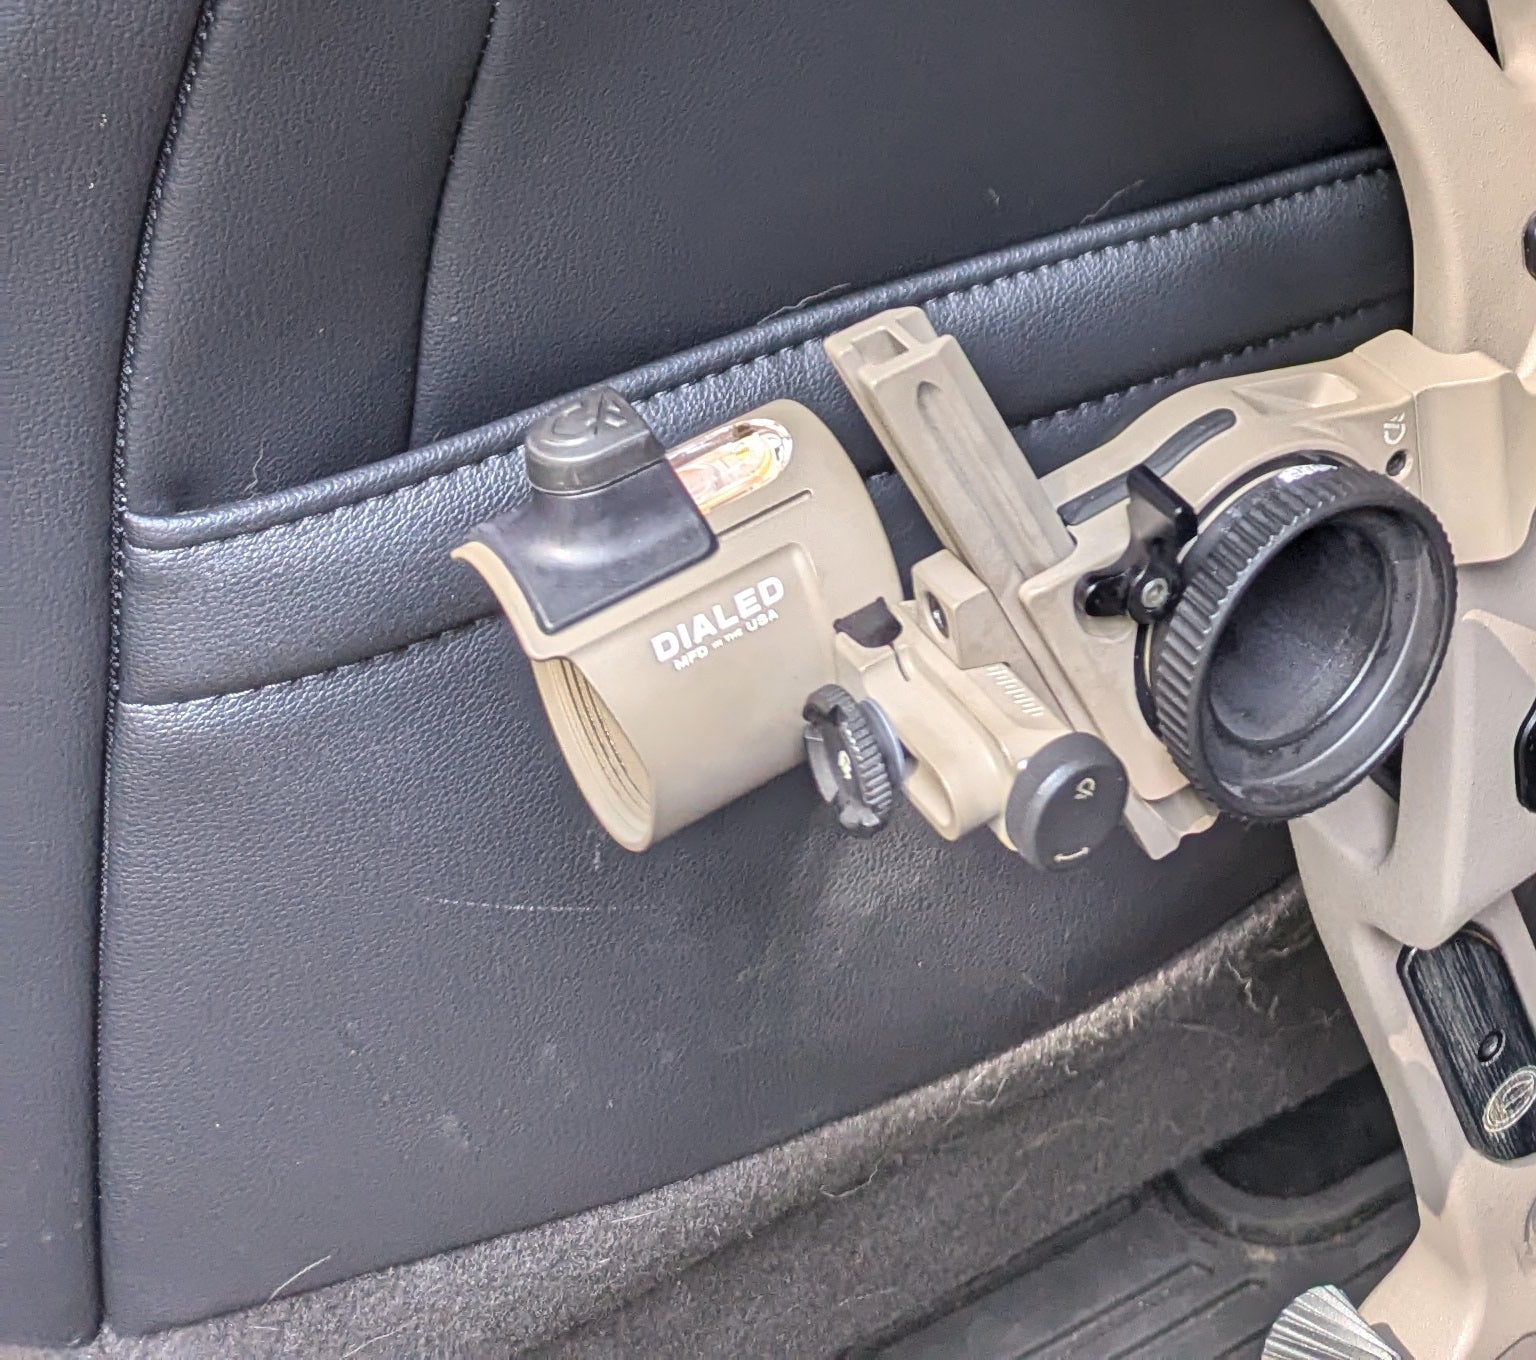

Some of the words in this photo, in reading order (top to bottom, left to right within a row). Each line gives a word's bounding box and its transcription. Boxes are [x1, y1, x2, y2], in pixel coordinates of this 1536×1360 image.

[650, 577, 785, 663] DIALED
[673, 645, 709, 671] MFD
[711, 638, 724, 649] IN
[723, 627, 744, 643] THE
[745, 608, 779, 632] USA
